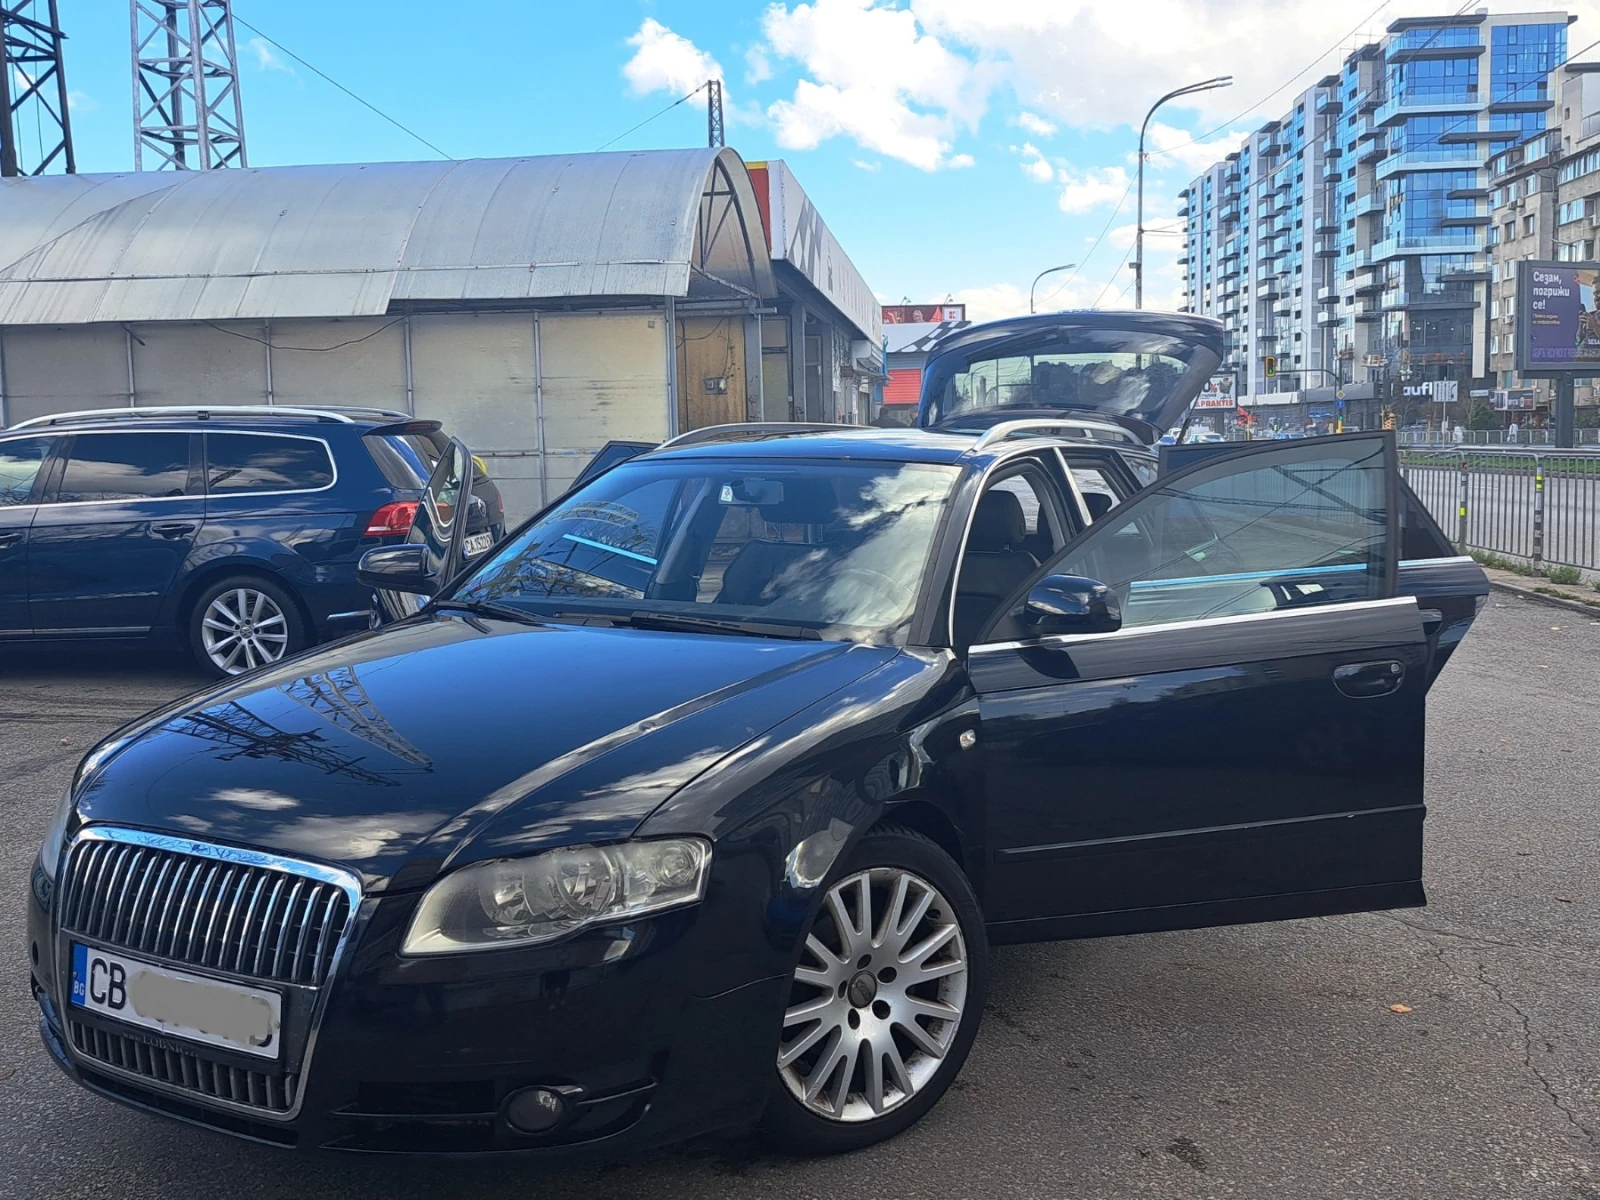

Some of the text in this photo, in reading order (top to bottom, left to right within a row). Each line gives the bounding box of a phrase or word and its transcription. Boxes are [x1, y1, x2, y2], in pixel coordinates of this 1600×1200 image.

[1533, 271, 1562, 284] Сезам,
[1532, 299, 1546, 310] се!
[73, 981, 85, 996] BG
